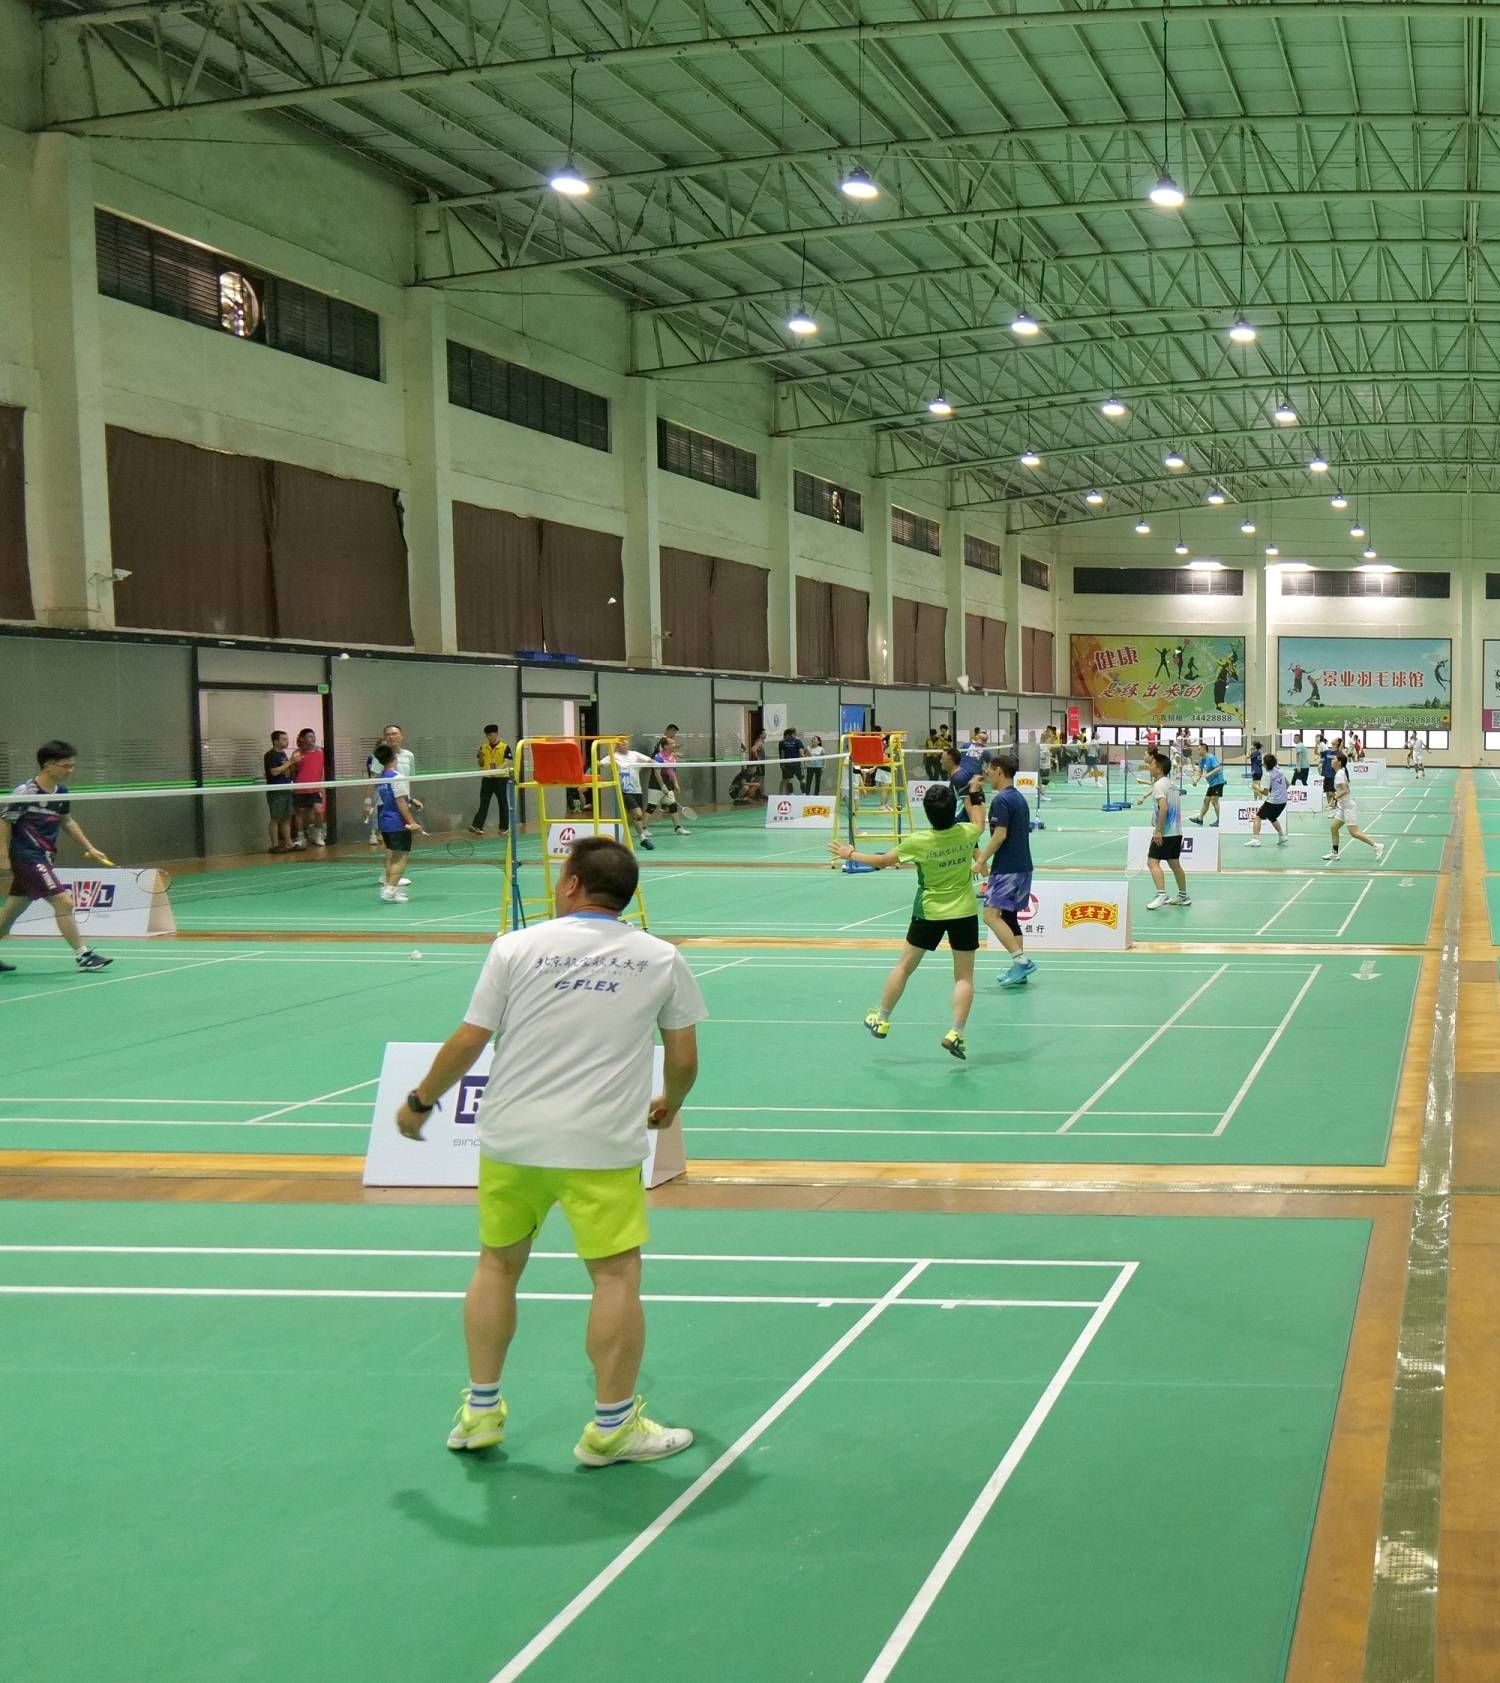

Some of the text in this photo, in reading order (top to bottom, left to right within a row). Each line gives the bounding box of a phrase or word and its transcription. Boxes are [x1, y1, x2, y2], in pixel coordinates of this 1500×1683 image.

[1094, 647, 1138, 671] 健康
[1322, 671, 1424, 688] 景业羽毛球馆
[1074, 907, 1108, 919] 王老吉
[573, 979, 619, 992] FLEX
